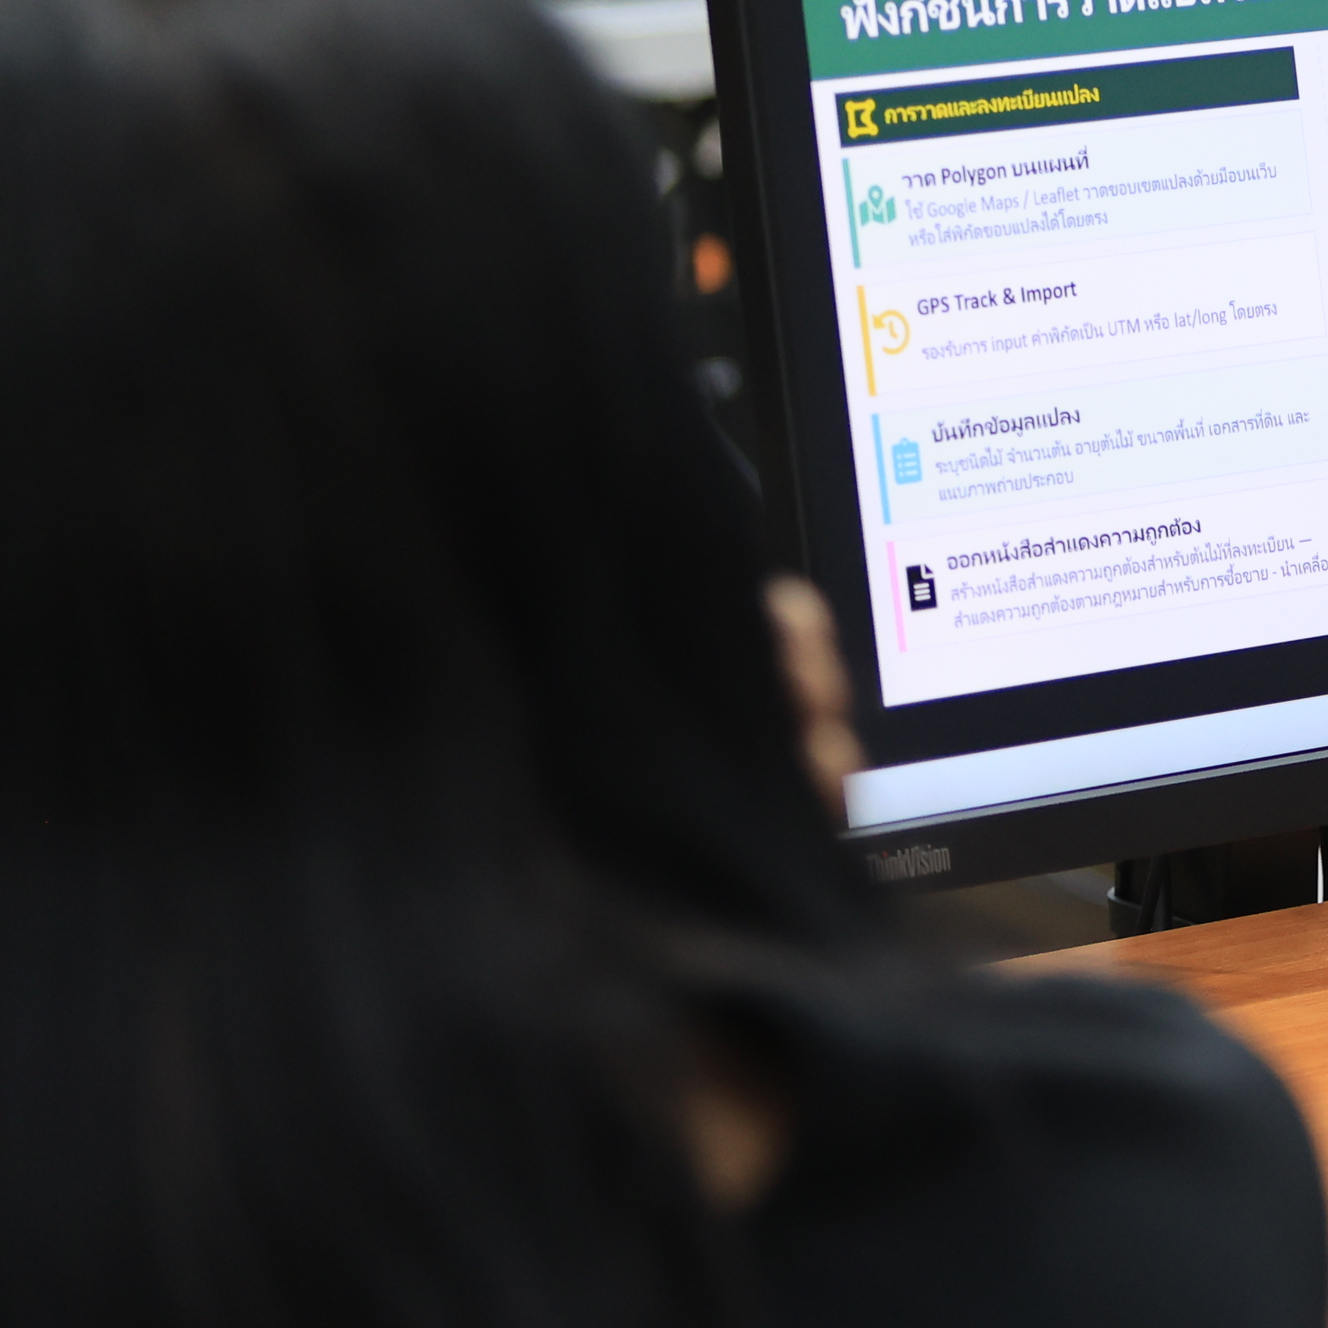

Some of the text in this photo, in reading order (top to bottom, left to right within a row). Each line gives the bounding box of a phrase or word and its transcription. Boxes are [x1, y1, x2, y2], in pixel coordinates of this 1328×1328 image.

[940, 164, 1008, 187] Polygon
[925, 197, 978, 219] Google
[979, 194, 1020, 213] Maps
[1032, 185, 1081, 206] Leaflet
[916, 280, 1078, 316] GPS Track & Import
[990, 332, 1029, 354] input
[1106, 316, 1141, 337] UTM
[1173, 307, 1228, 329] lat/long
